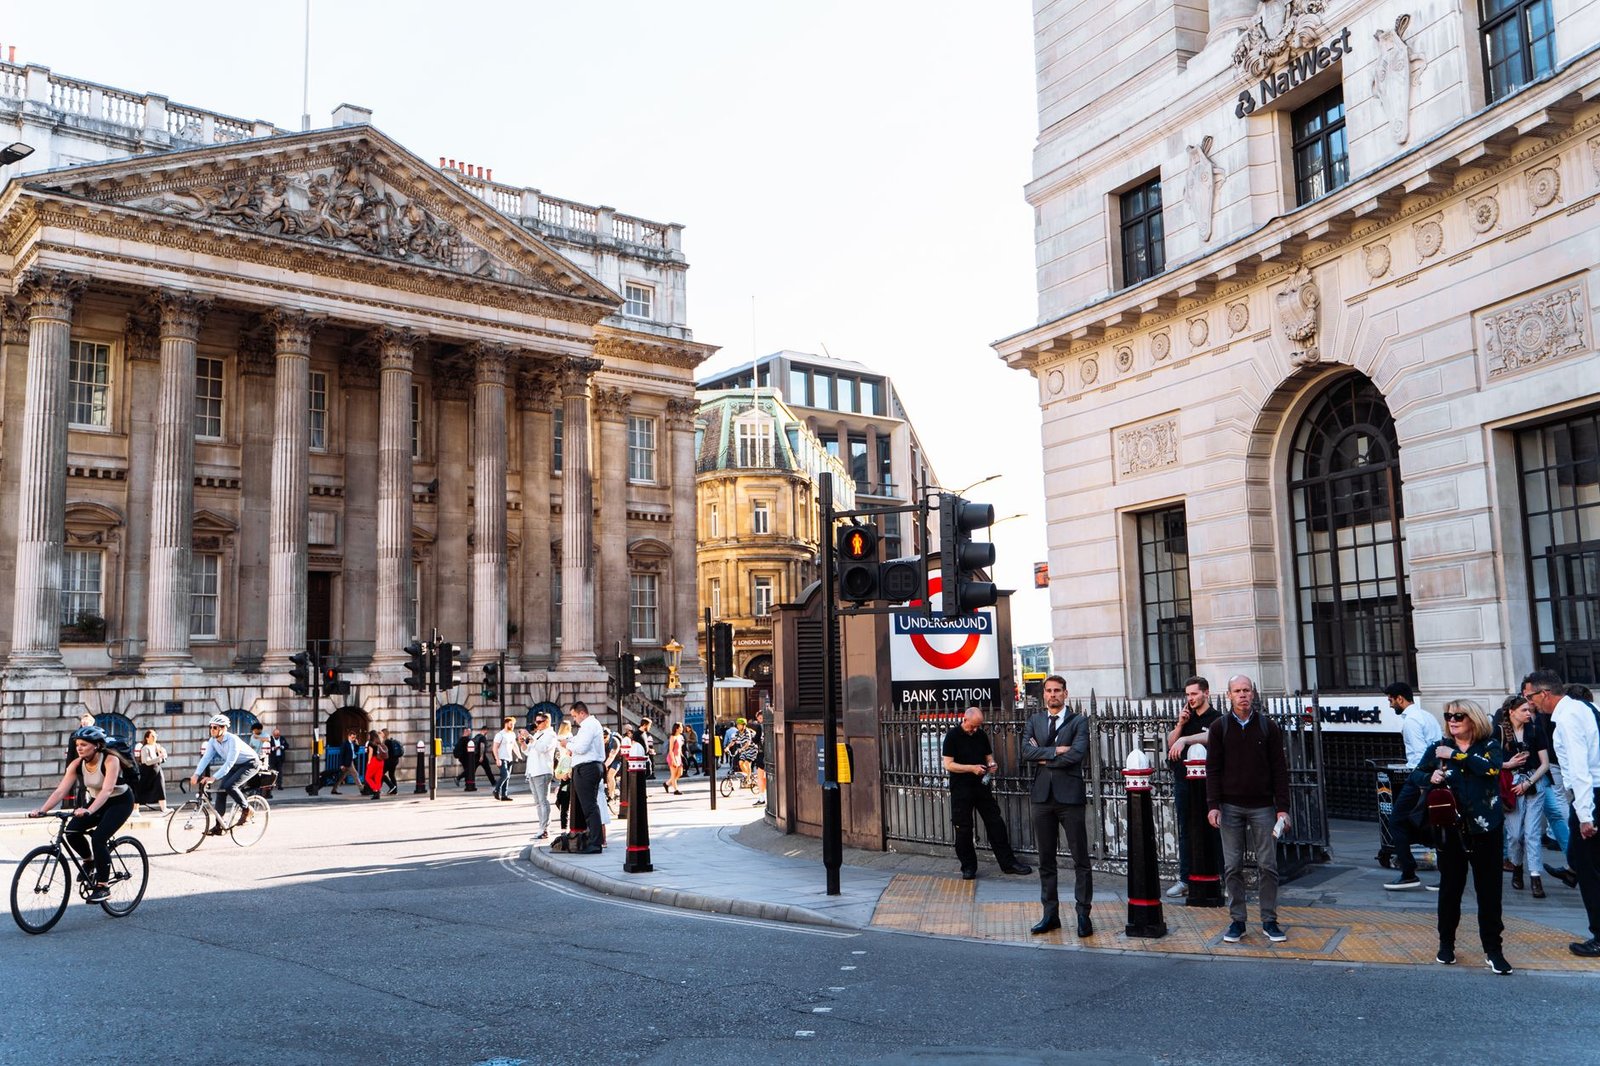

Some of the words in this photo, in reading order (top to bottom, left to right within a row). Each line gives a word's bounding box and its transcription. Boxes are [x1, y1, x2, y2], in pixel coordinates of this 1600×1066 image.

[1260, 26, 1352, 104] NatWest
[903, 689, 937, 703] BANK
[942, 688, 991, 701] STATION
[1319, 706, 1381, 723] NatWest
